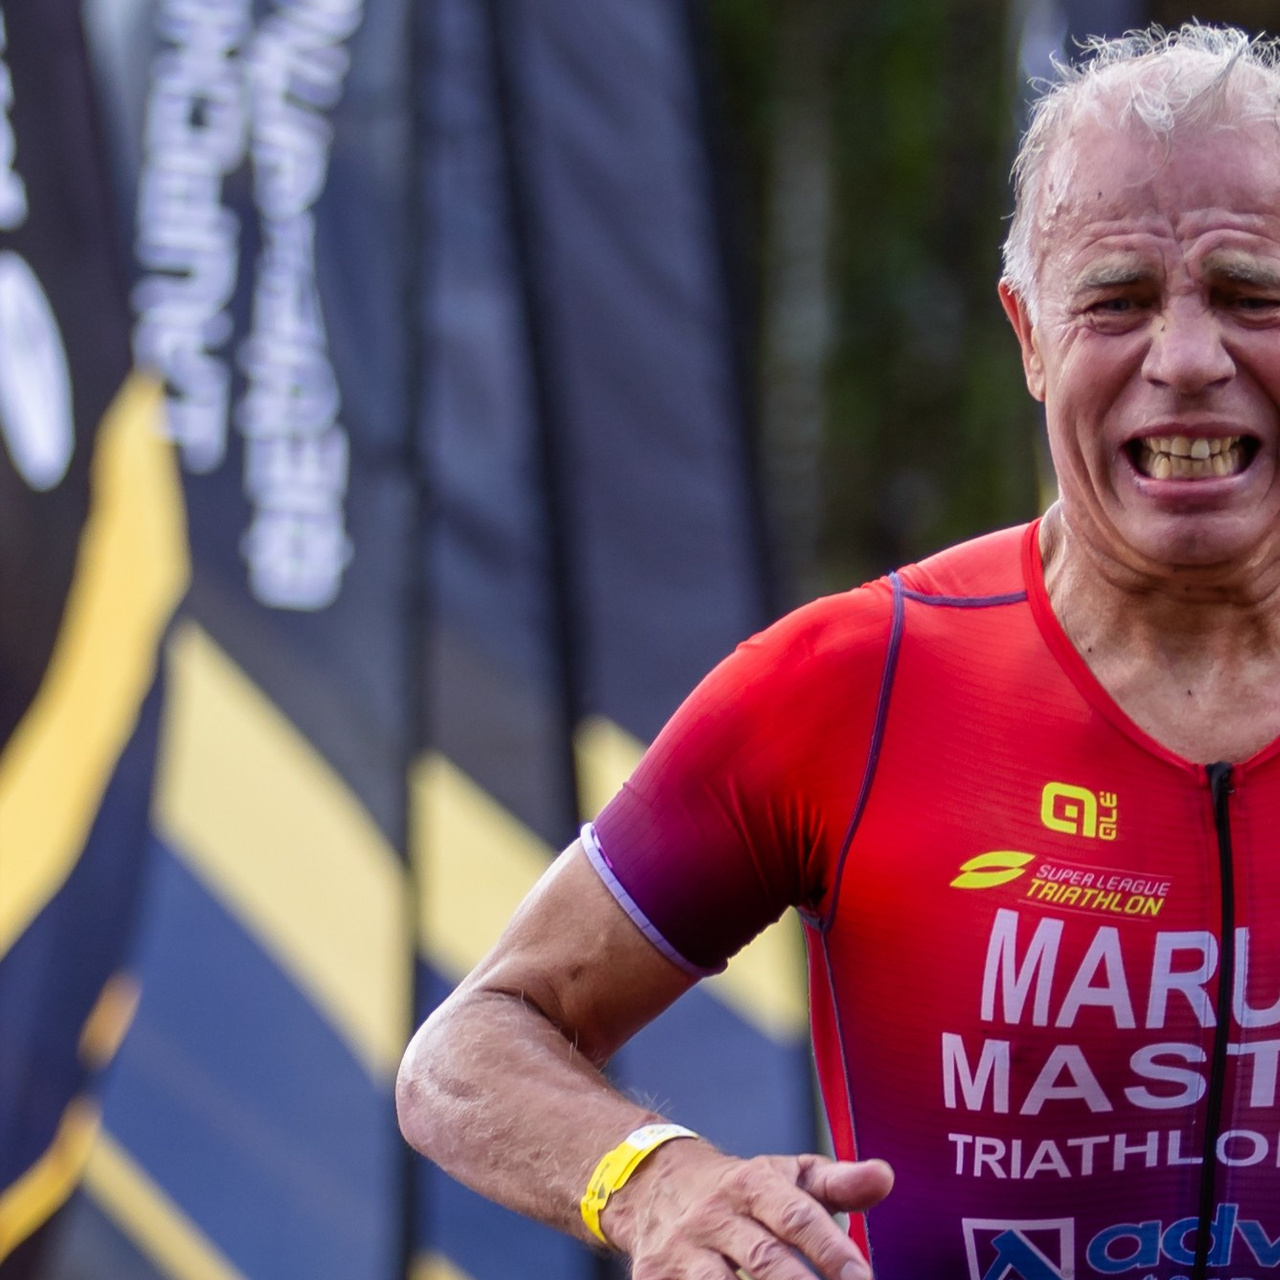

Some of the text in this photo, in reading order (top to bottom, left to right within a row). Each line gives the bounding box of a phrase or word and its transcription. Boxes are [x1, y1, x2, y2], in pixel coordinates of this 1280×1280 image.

[1026, 878, 1164, 916] TRIATHLON
[1035, 864, 1172, 897] SUPER LEAGUE
